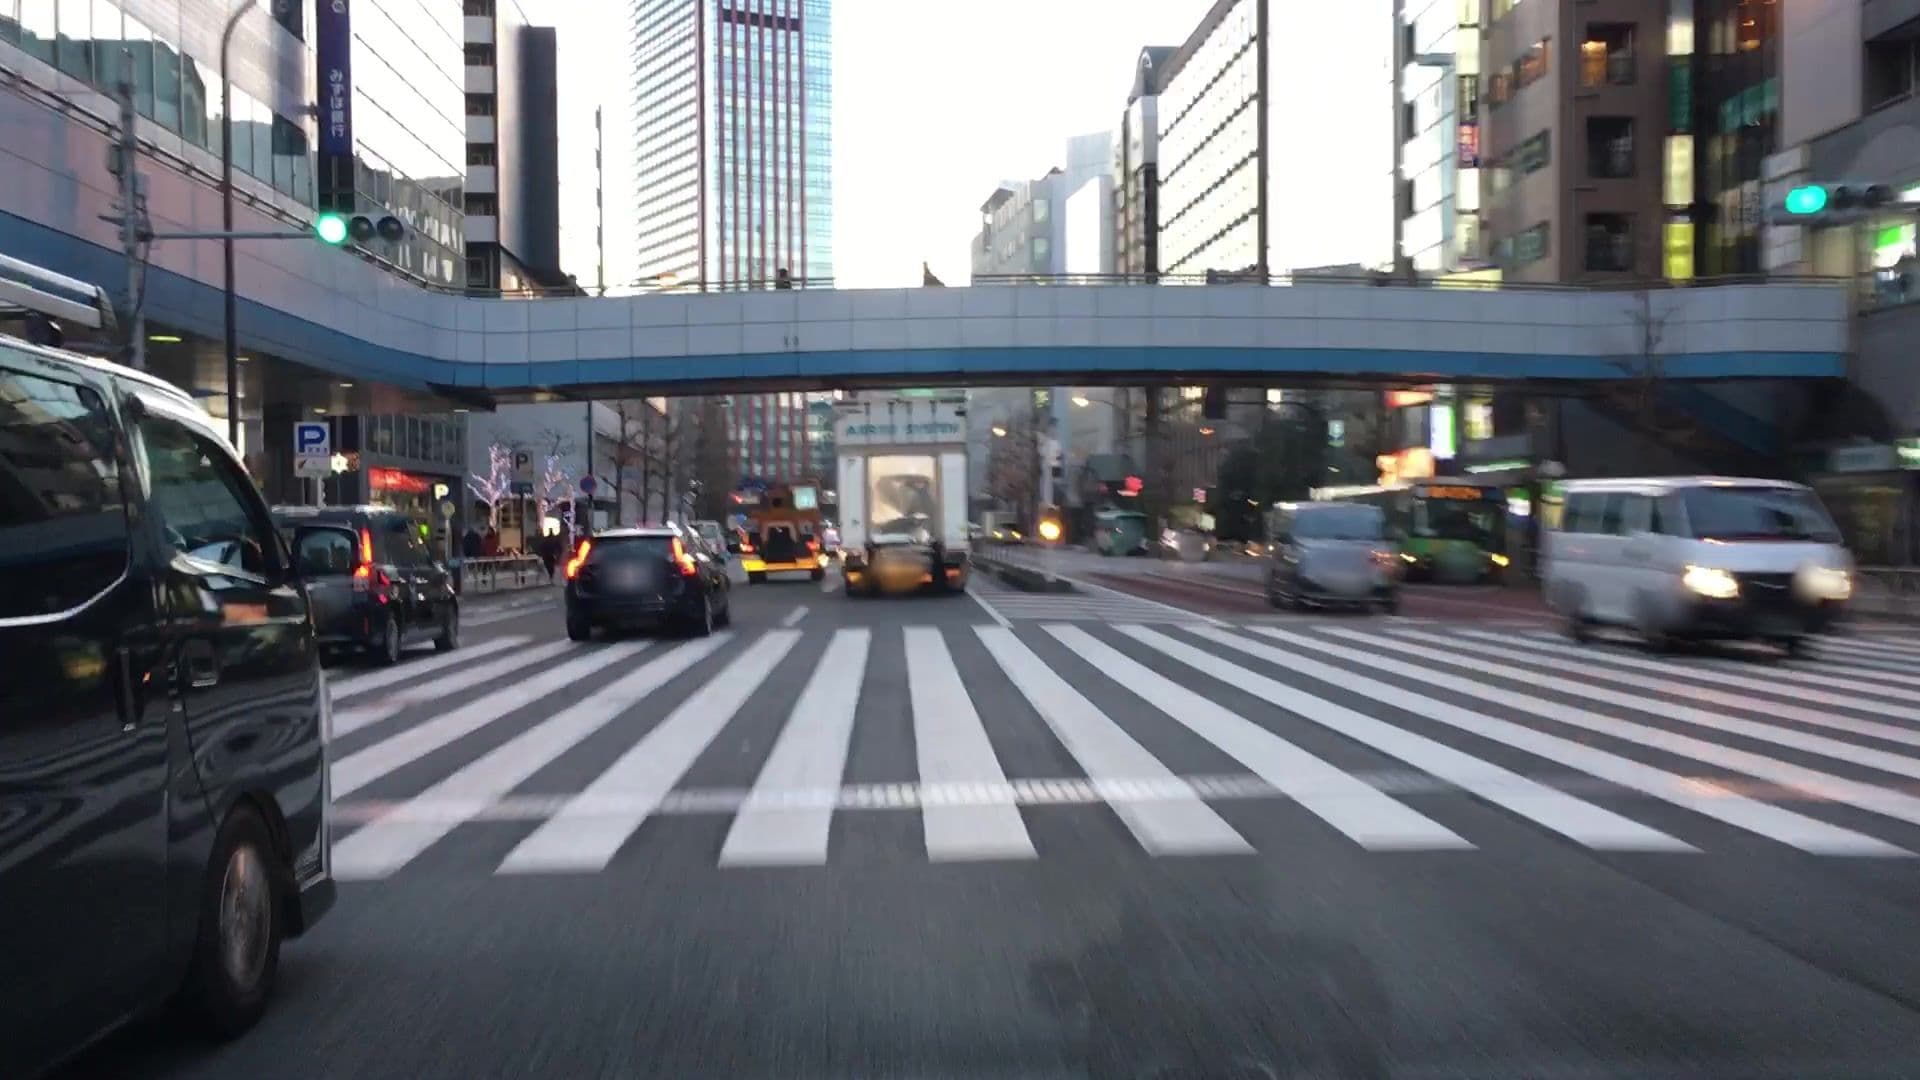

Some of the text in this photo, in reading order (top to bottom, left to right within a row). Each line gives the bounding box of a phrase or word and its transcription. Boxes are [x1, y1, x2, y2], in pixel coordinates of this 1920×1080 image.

[298, 425, 326, 453] P
[515, 453, 529, 470] P
[434, 483, 450, 500] P
